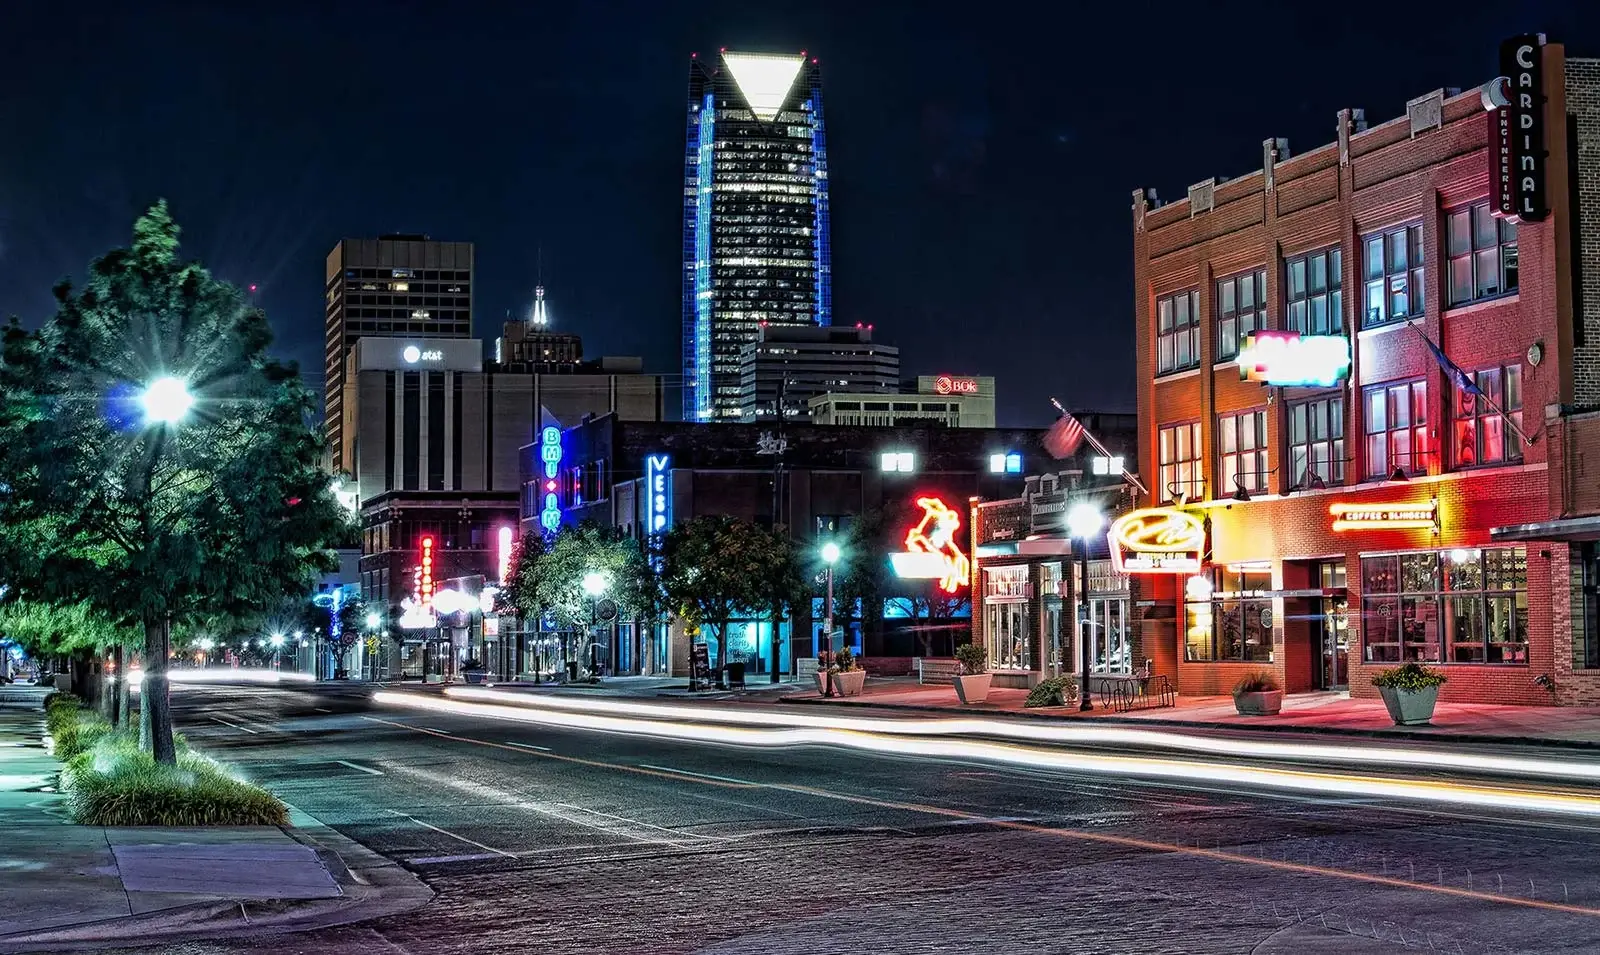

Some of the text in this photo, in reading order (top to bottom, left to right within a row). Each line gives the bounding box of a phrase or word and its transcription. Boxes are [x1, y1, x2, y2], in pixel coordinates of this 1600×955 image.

[1500, 109, 1510, 211] ENGINEERING
[544, 428, 560, 477] BMI
[1346, 511, 1382, 521] COFFEE
